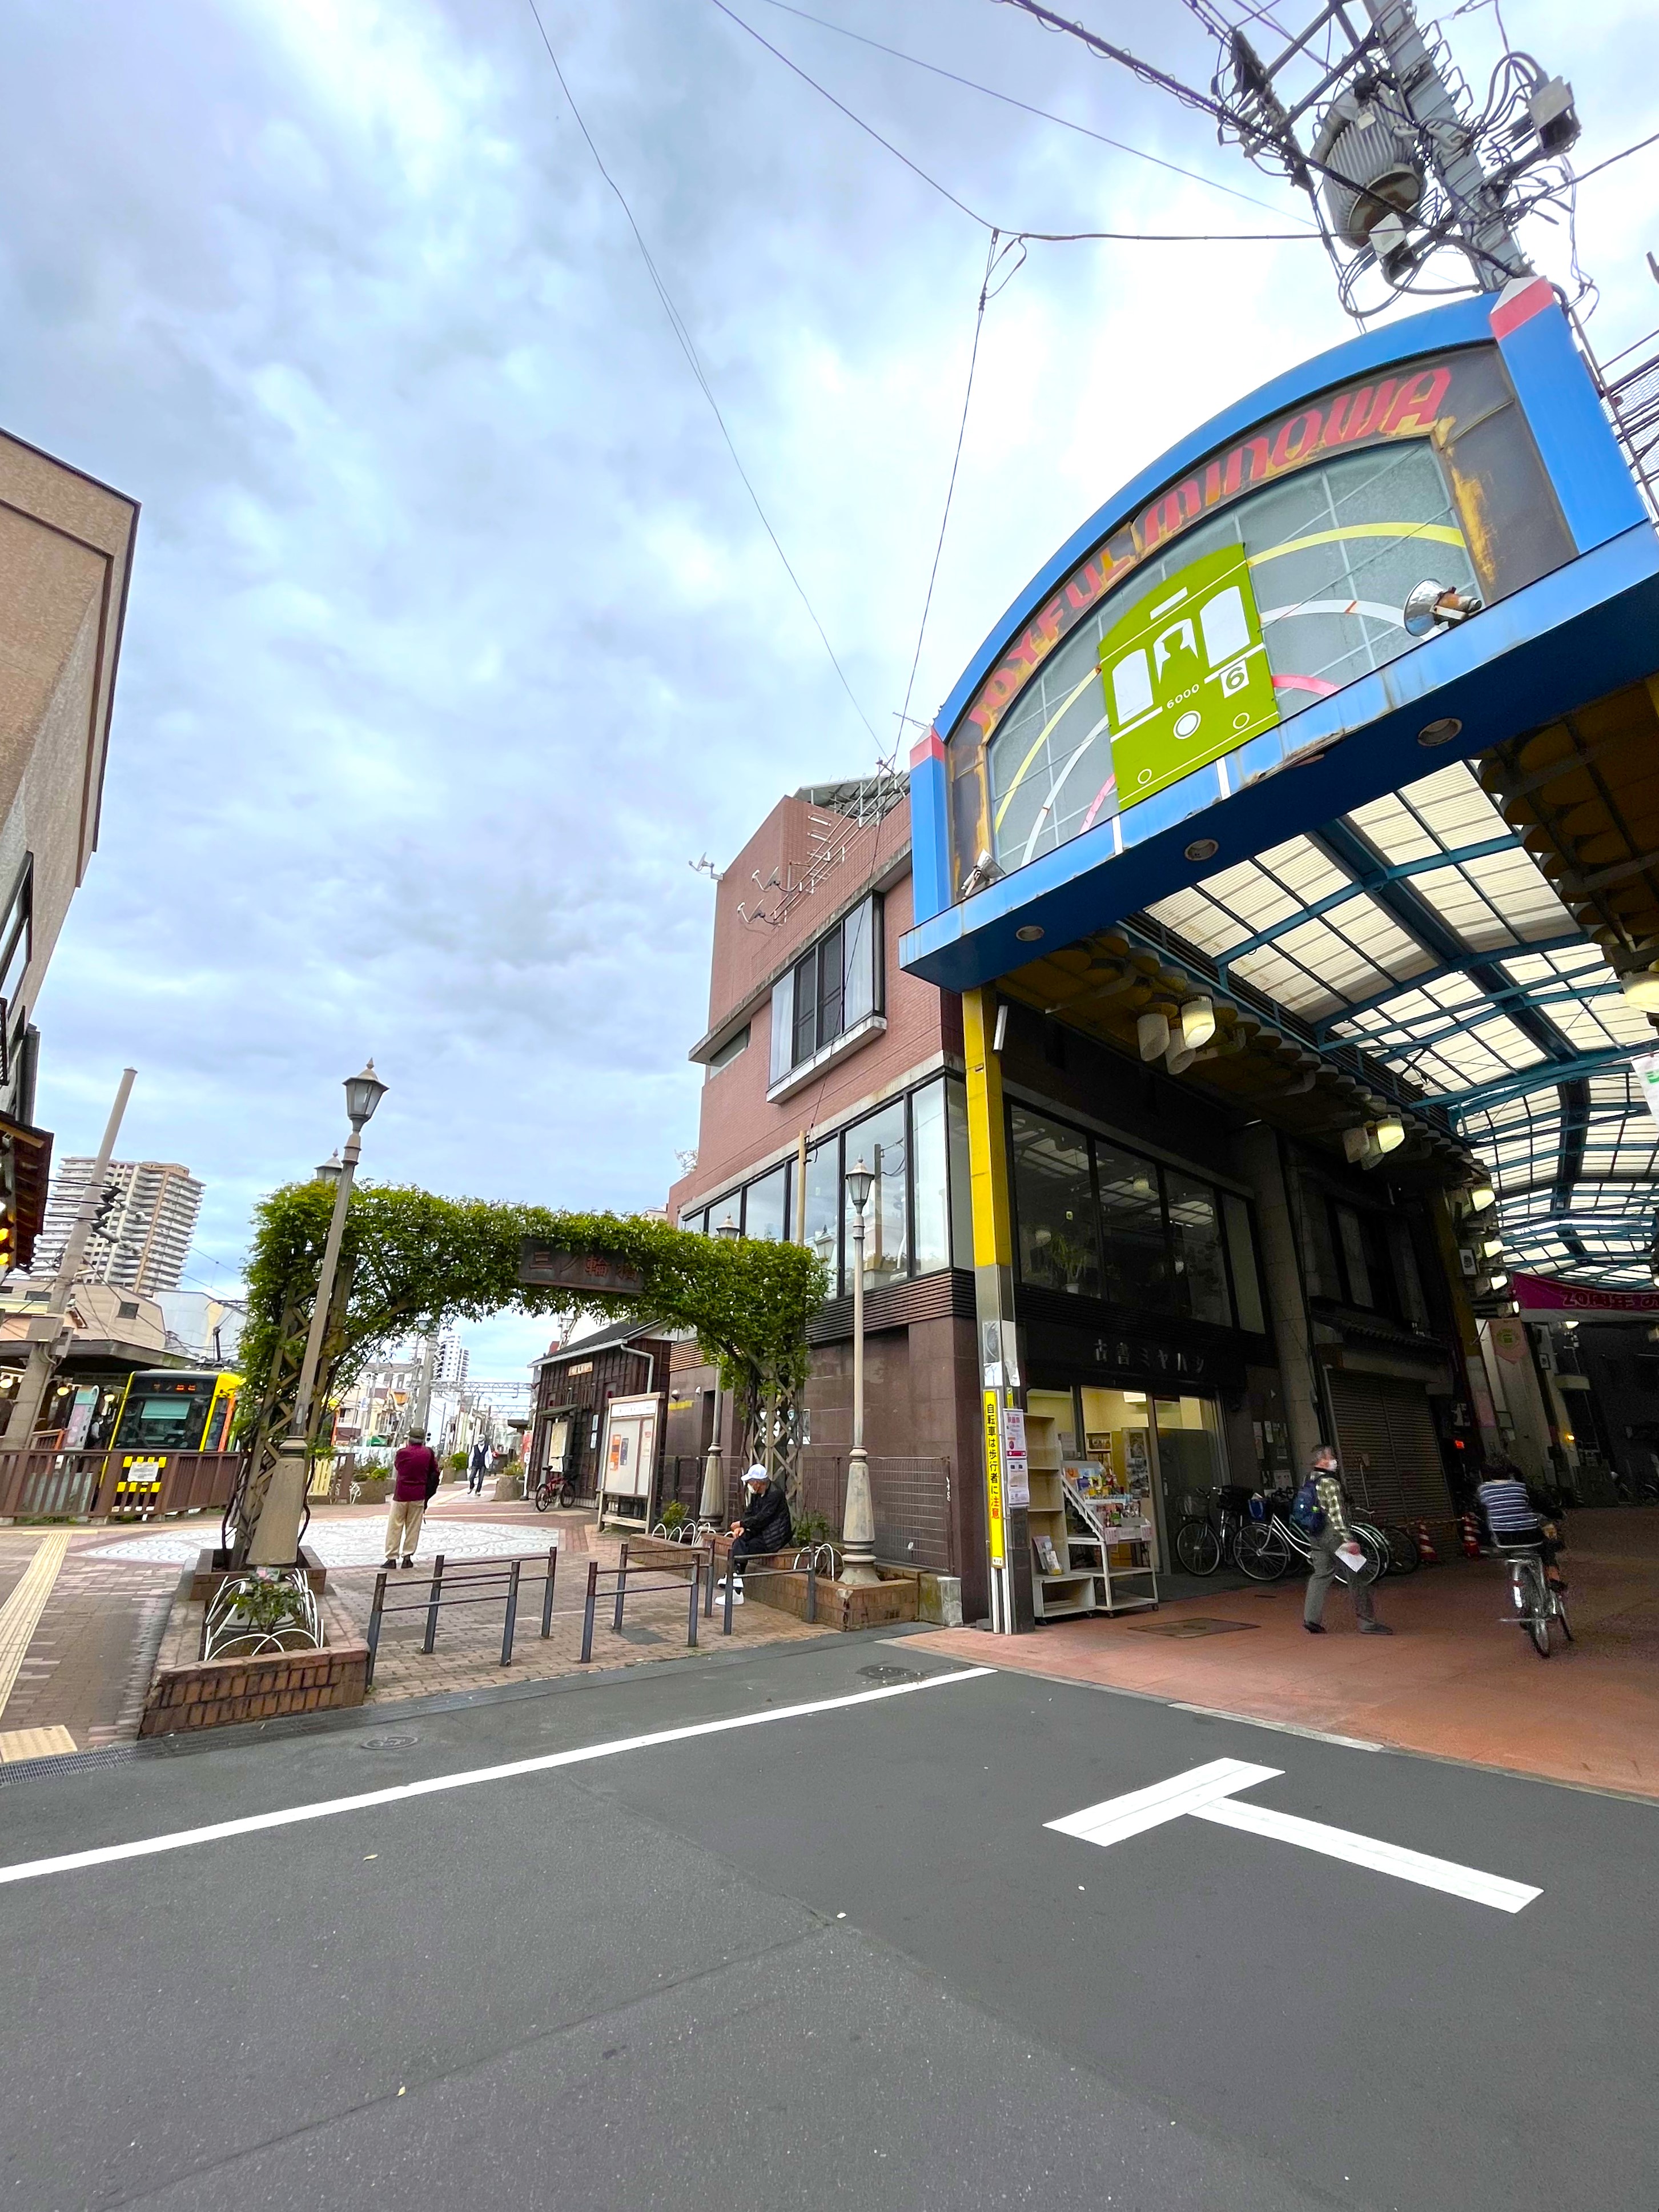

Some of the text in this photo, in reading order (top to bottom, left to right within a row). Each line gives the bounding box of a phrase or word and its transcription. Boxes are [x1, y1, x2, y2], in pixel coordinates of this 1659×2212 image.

[968, 546, 1131, 737] JOYFUL
[1226, 666, 1245, 691] 6
[1166, 684, 1200, 709] 6000
[529, 1251, 638, 1281] 三ノ輪橋
[986, 1403, 1000, 1519] 自転車は歩行者に注意
